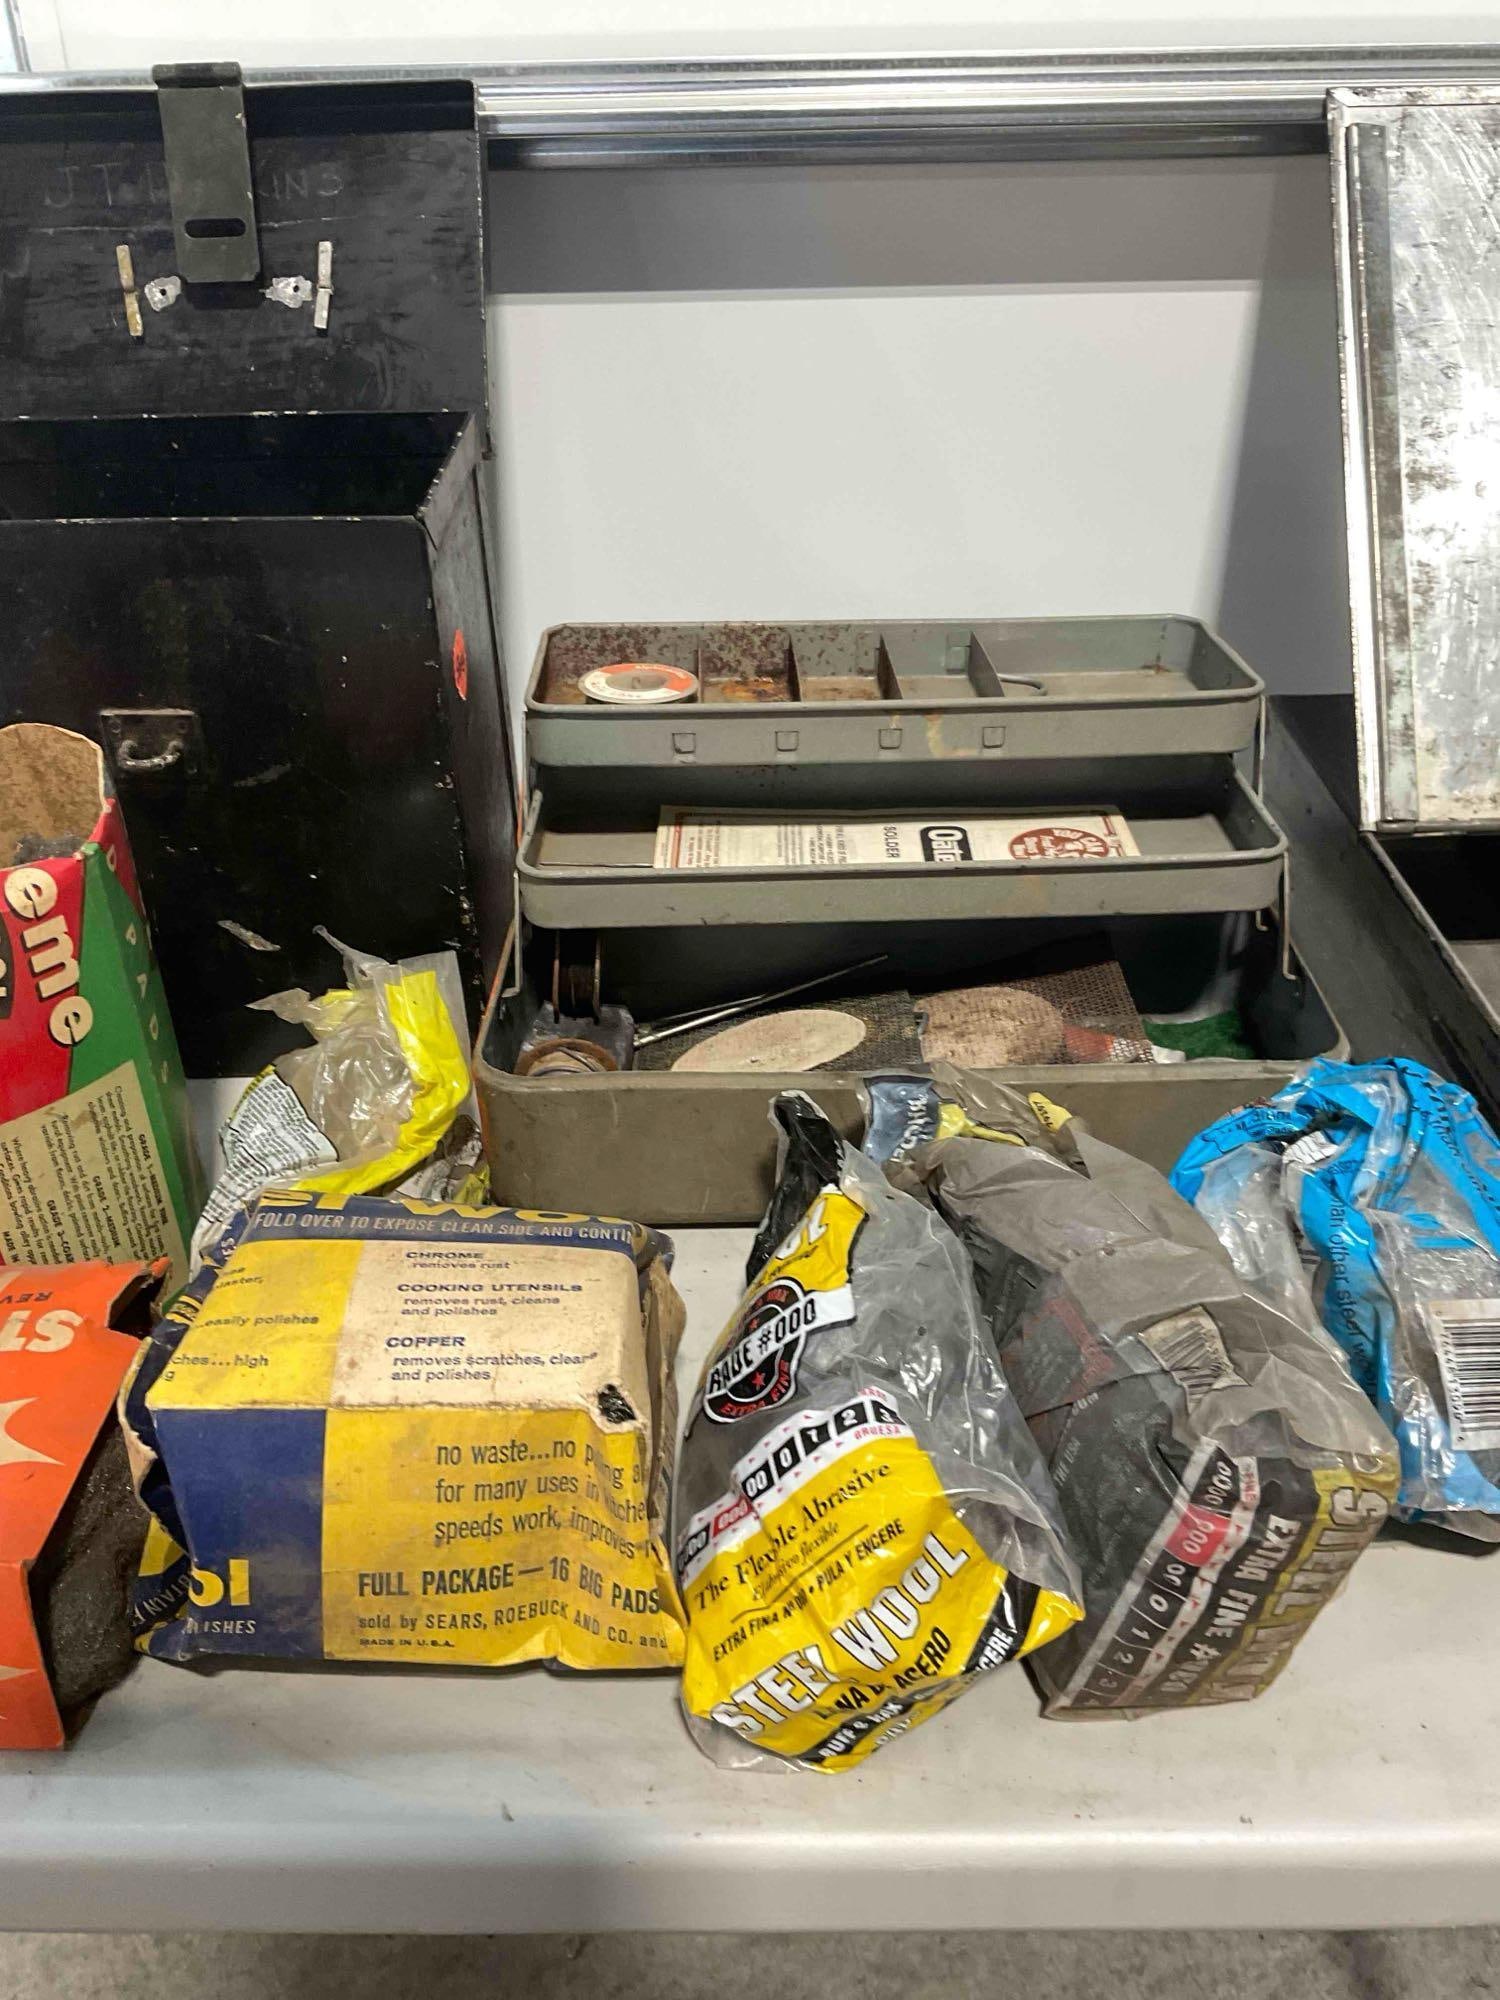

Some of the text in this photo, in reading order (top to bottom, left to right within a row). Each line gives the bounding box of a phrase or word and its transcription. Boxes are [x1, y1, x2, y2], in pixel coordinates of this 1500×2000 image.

[884, 825, 899, 858] SOLDER
[112, 1085, 129, 1117] Cleaning
[59, 1114, 77, 1149] Removing
[122, 1117, 133, 1131] and
[11, 1136, 26, 1161] Where
[72, 1150, 81, 1163] rust
[98, 1136, 112, 1164] windows
[106, 1165, 117, 1179] and
[117, 1134, 134, 1170] Smoothing
[125, 1133, 142, 1172] preparation
[18, 1161, 33, 1183] heavy
[40, 1123, 55, 1148] varnish
[48, 1149, 60, 1167] from
[68, 1211, 84, 1238] painted
[76, 1164, 87, 1178] and
[27, 1183, 43, 1213] abrasive
[86, 1192, 98, 1209] from
[91, 1175, 106, 1202] GRADE
[8, 1199, 25, 1229] bowling
[18, 1229, 32, 1248] alley
[18, 1194, 32, 1215] rapid
[35, 1238, 45, 1249] for
[37, 1212, 51, 1234] action
[46, 1199, 62, 1227] GRADE
[255, 1213, 573, 1238] FOLD OVER TO EXPOSE CLEAN SIDE AND
[2, 1230, 18, 1263] MADE IN
[406, 1252, 484, 1260] CHROME
[412, 1262, 476, 1270] removes
[1330, 1235, 1348, 1296] other
[397, 1284, 583, 1293] COOKING UTENSILS
[404, 1296, 561, 1306] removes rust, cleans
[253, 1313, 319, 1327] polishes
[401, 1307, 498, 1317] and polishes
[385, 1336, 467, 1349] COPPER
[392, 1356, 461, 1367] removes
[391, 1370, 491, 1383] and polishes
[720, 1360, 791, 1416] EXTRA FINE
[436, 1446, 462, 1465] no
[745, 1472, 768, 1497] 00
[781, 1450, 795, 1468] 0
[841, 1409, 858, 1425] 2
[435, 1479, 465, 1503] for
[474, 1479, 528, 1502] many
[537, 1475, 579, 1494] uses
[1204, 1461, 1232, 1505] 0000
[435, 1513, 504, 1544] speeds
[512, 1505, 562, 1532] work,
[570, 1506, 636, 1560] improves
[697, 1462, 892, 1611] The Abrasive
[1183, 1522, 1215, 1554] 000
[358, 1571, 409, 1597] FULL
[549, 1555, 570, 1582] 16
[578, 1563, 604, 1599] BIG
[611, 1581, 660, 1614] PADS
[713, 1626, 747, 1663] EXTRA
[749, 1612, 779, 1636] FINA
[816, 1563, 845, 1593] PULA
[855, 1517, 906, 1562] ENCERE
[1204, 1513, 1300, 1639] EXTRA FINE
[830, 1531, 972, 1673] WOOL
[1149, 1594, 1169, 1614] 0
[358, 1614, 391, 1629] sold
[399, 1615, 418, 1632] by
[425, 1611, 488, 1631] SEARS,
[494, 1599, 569, 1626] ROEBUCK
[573, 1611, 601, 1636] AND
[606, 1625, 634, 1645] CO.
[1130, 1625, 1150, 1641] 1
[360, 1638, 455, 1648] MADE IN U.S.A.
[895, 1625, 951, 1690] ACERO
[1114, 1651, 1135, 1665] 2
[818, 1721, 852, 1759] BUFF
[869, 1698, 905, 1723] WAX
